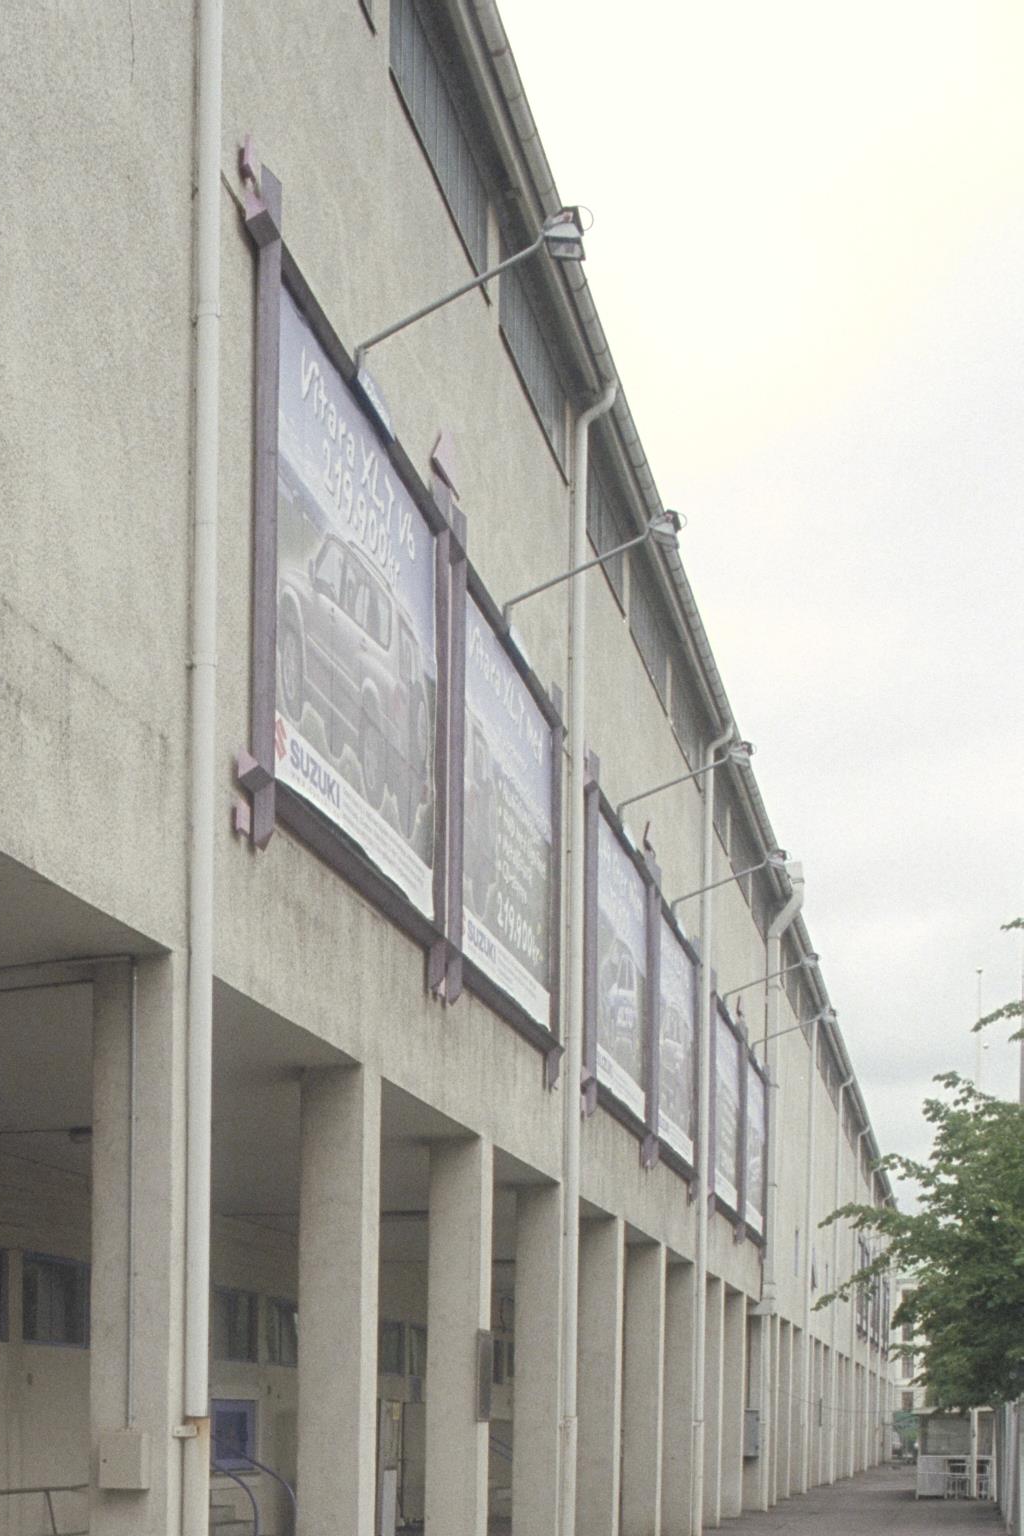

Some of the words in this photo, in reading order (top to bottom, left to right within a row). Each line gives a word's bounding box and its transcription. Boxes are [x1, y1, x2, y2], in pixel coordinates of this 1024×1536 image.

[301, 346, 354, 470] Vitara
[399, 506, 415, 562] V6
[289, 738, 340, 810] SUZUKI
[467, 918, 497, 965] SUZUKI
